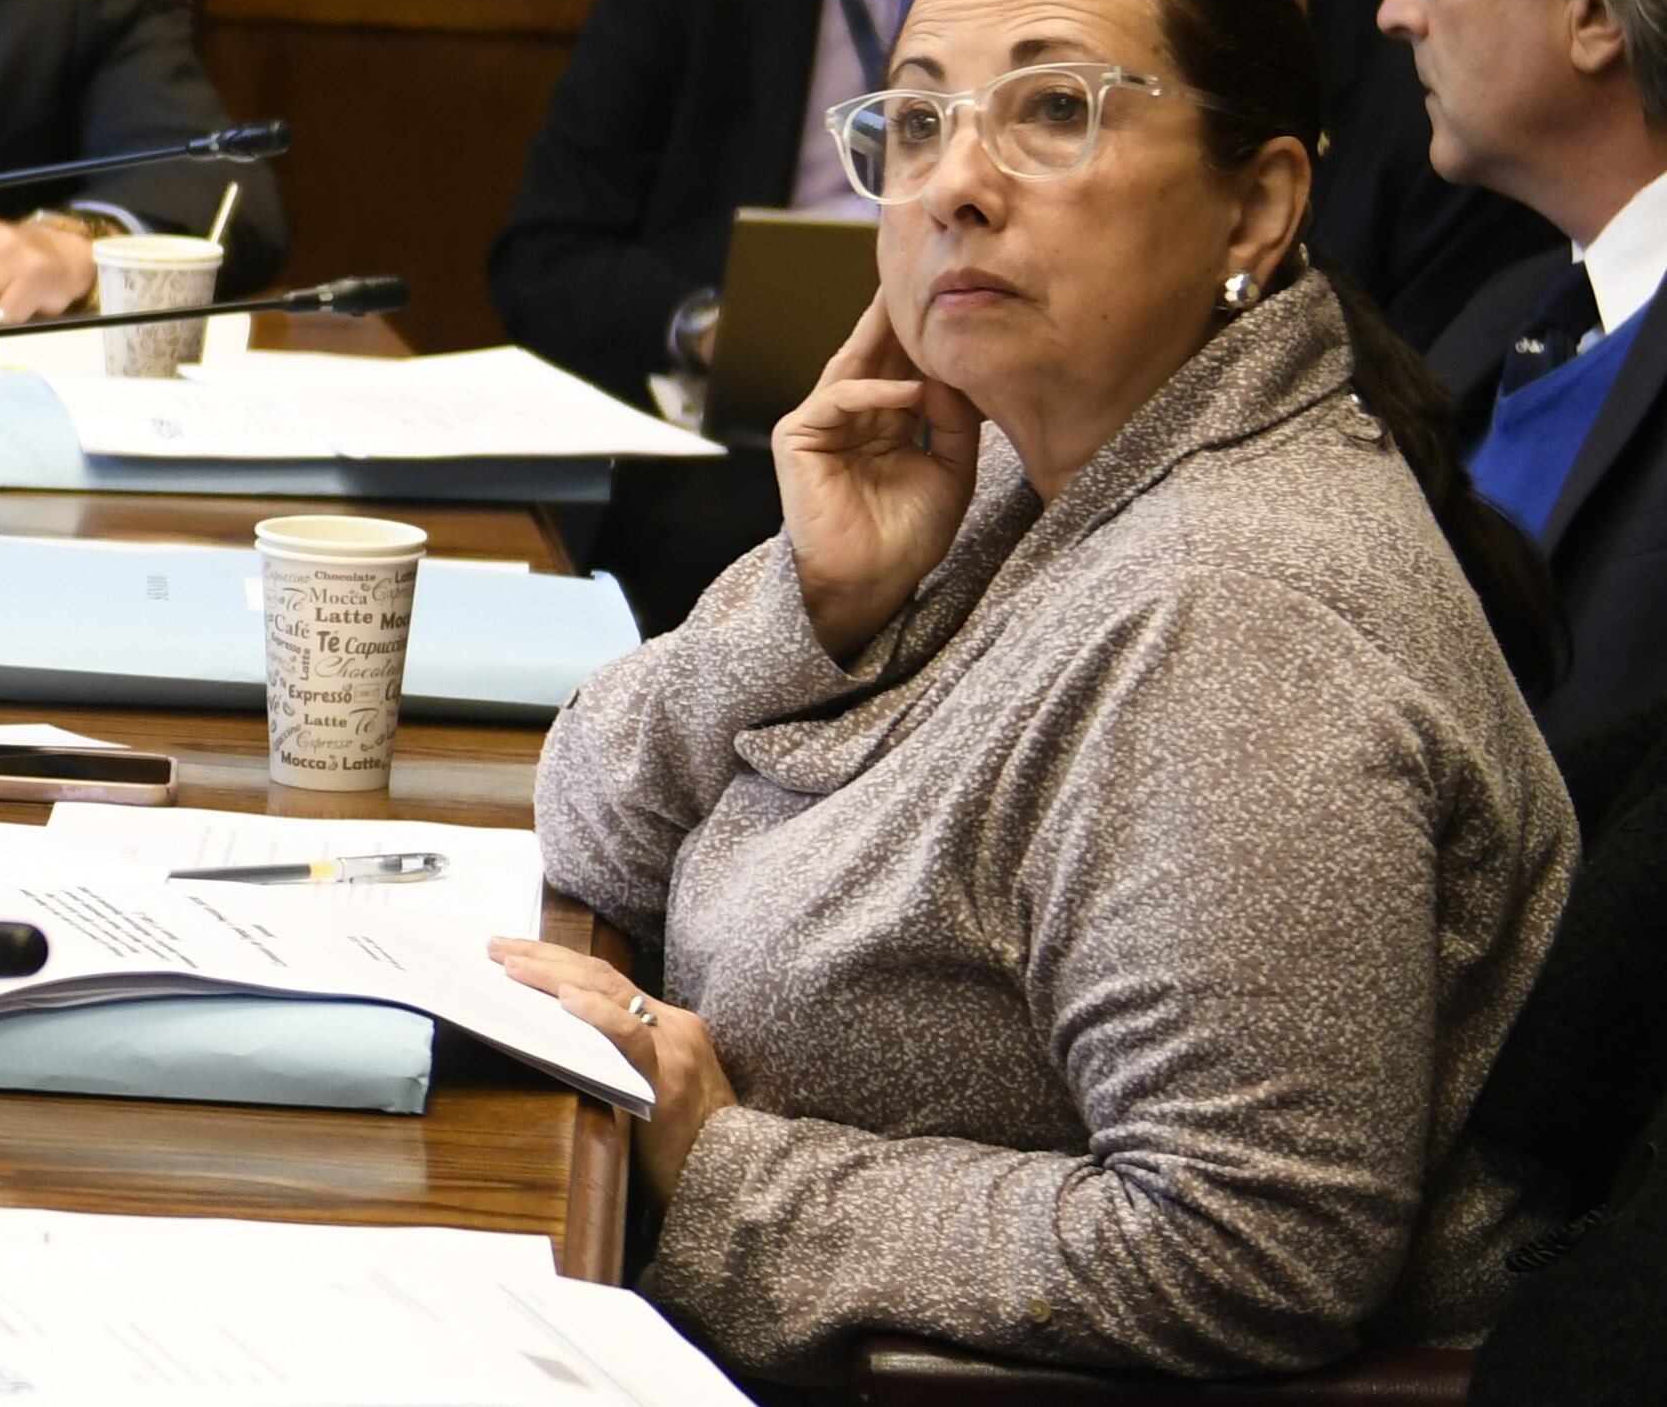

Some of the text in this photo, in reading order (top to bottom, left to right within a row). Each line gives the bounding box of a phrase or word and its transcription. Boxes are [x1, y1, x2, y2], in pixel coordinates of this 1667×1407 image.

[315, 570, 376, 583] Chocolate
[309, 587, 367, 606] Mocca
[315, 607, 373, 624] Latte
[274, 614, 310, 639] Café
[317, 630, 340, 653] Té
[300, 648, 310, 681] Latte
[289, 684, 352, 706] Expresso
[304, 713, 347, 728] Latte
[281, 749, 326, 771] Mocca
[342, 756, 381, 771] Latte
